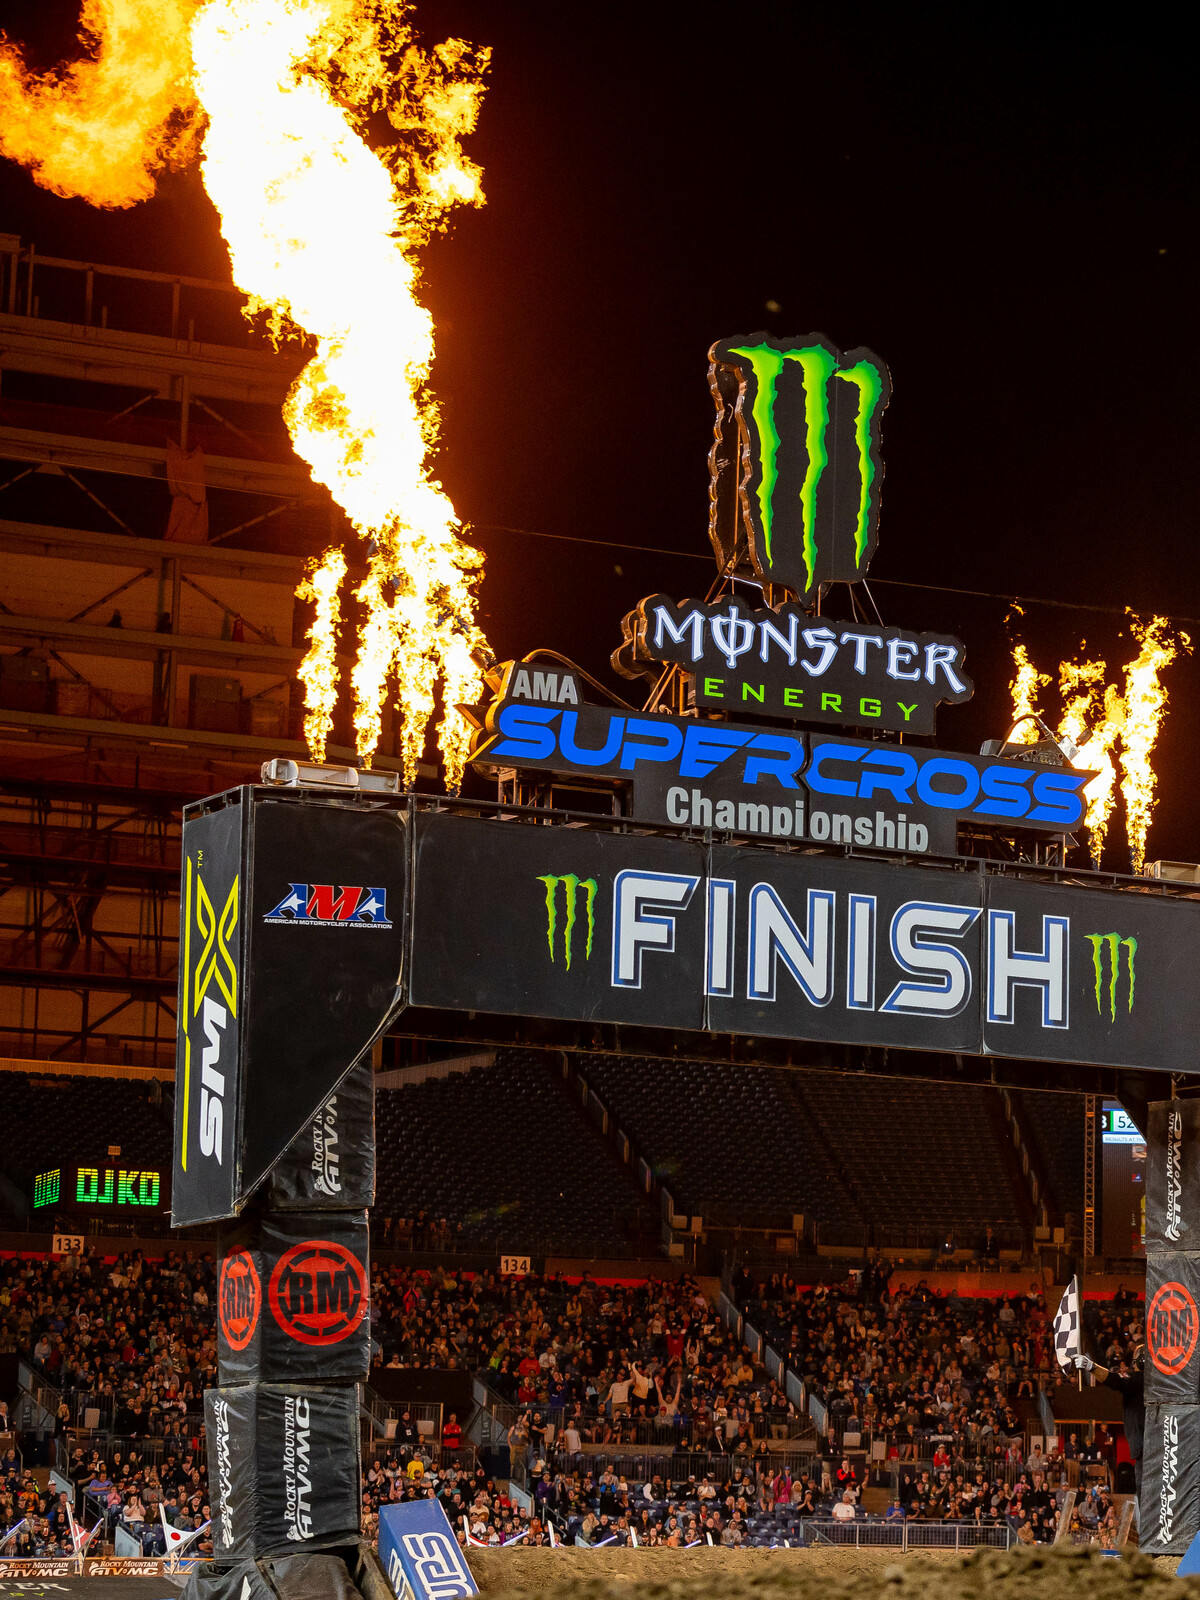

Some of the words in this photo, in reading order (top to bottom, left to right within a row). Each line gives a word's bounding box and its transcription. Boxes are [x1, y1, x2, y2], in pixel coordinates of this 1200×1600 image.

[652, 605, 968, 694] MONSTER
[512, 669, 579, 705] AMA
[704, 677, 919, 721] ENERGY
[490, 704, 1100, 824] SUPERCROSS
[666, 786, 929, 853] Championship
[262, 883, 394, 924] AMA
[299, 919, 349, 928] MOTORCYCLIST
[349, 922, 393, 930] ASSOCIATION
[610, 868, 1070, 1030] FINISH
[311, 1126, 324, 1173] ROCKY
[1166, 1112, 1176, 1179] MOUNTAIN
[1166, 1181, 1175, 1221] ROCKY
[56, 1238, 82, 1252] 133
[503, 1259, 528, 1273] 134
[287, 1270, 352, 1316] RM
[1156, 1308, 1190, 1349] RM
[282, 1396, 295, 1475] MOUNTAIN
[1161, 1415, 1170, 1484] MOUNTAIN
[283, 1474, 297, 1522] ROCKY
[1159, 1485, 1167, 1526] ROCKY
[32, 1561, 69, 1569] MOUNTAIN
[99, 1560, 122, 1568] ROCKY
[122, 1560, 159, 1568] MOUNTAIN
